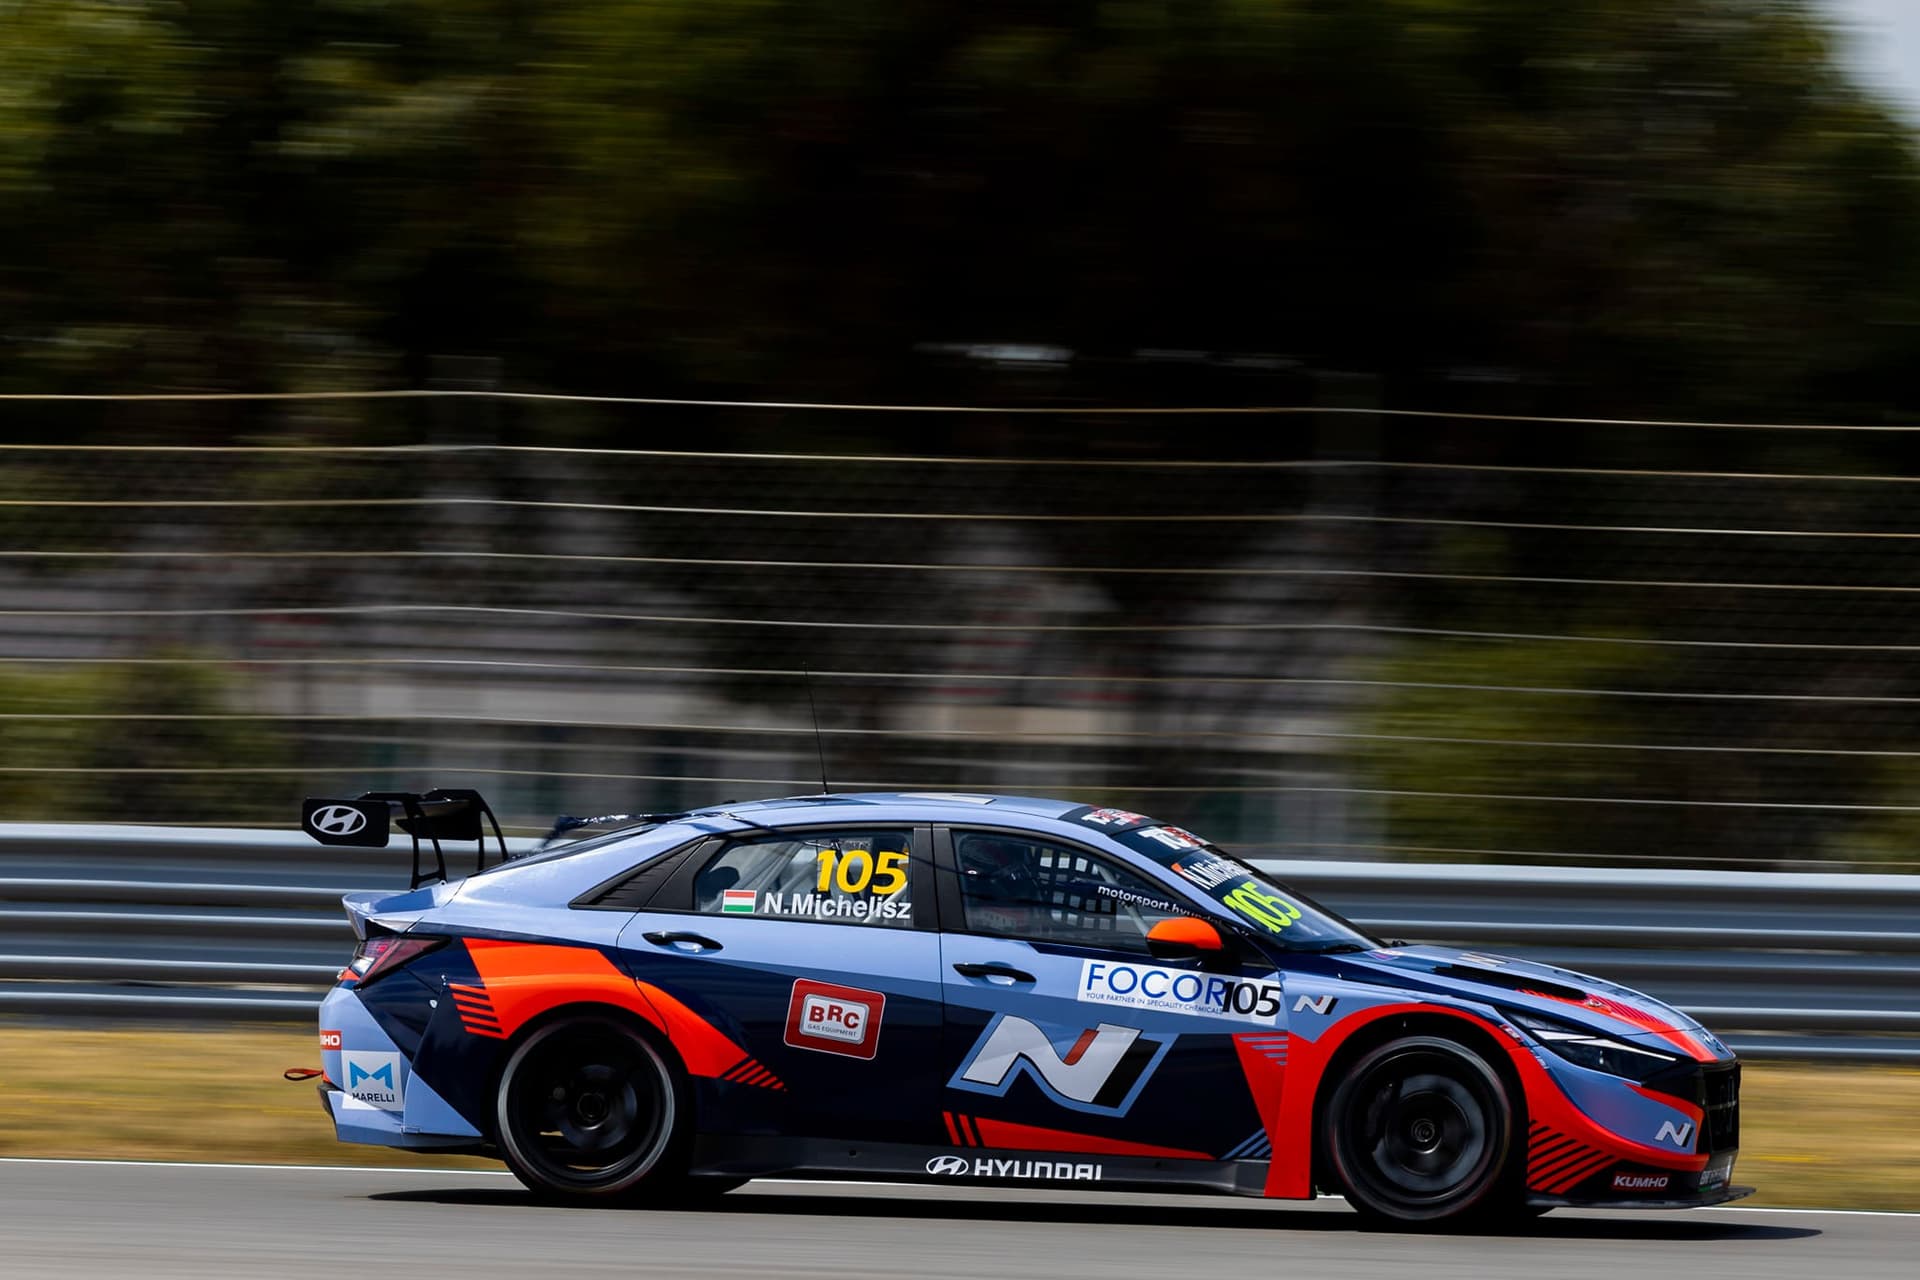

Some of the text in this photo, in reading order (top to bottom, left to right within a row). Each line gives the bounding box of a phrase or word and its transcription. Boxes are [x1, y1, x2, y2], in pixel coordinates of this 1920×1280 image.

[817, 848, 909, 895] 105
[763, 892, 911, 919] N.Michelisz
[1223, 881, 1302, 933] 105
[1086, 992, 1104, 1000] YOUR
[1106, 994, 1136, 1003] PARTNER
[1147, 998, 1182, 1009] SPECIALITY
[1087, 964, 1282, 1018] FOCOR 105
[809, 1005, 860, 1029] BRC
[821, 1026, 857, 1036] EQUIPMENT
[352, 1092, 395, 1102] MARELLI
[974, 1157, 1102, 1181] HYUNDAI
[1614, 1175, 1669, 1188] KUMHO
